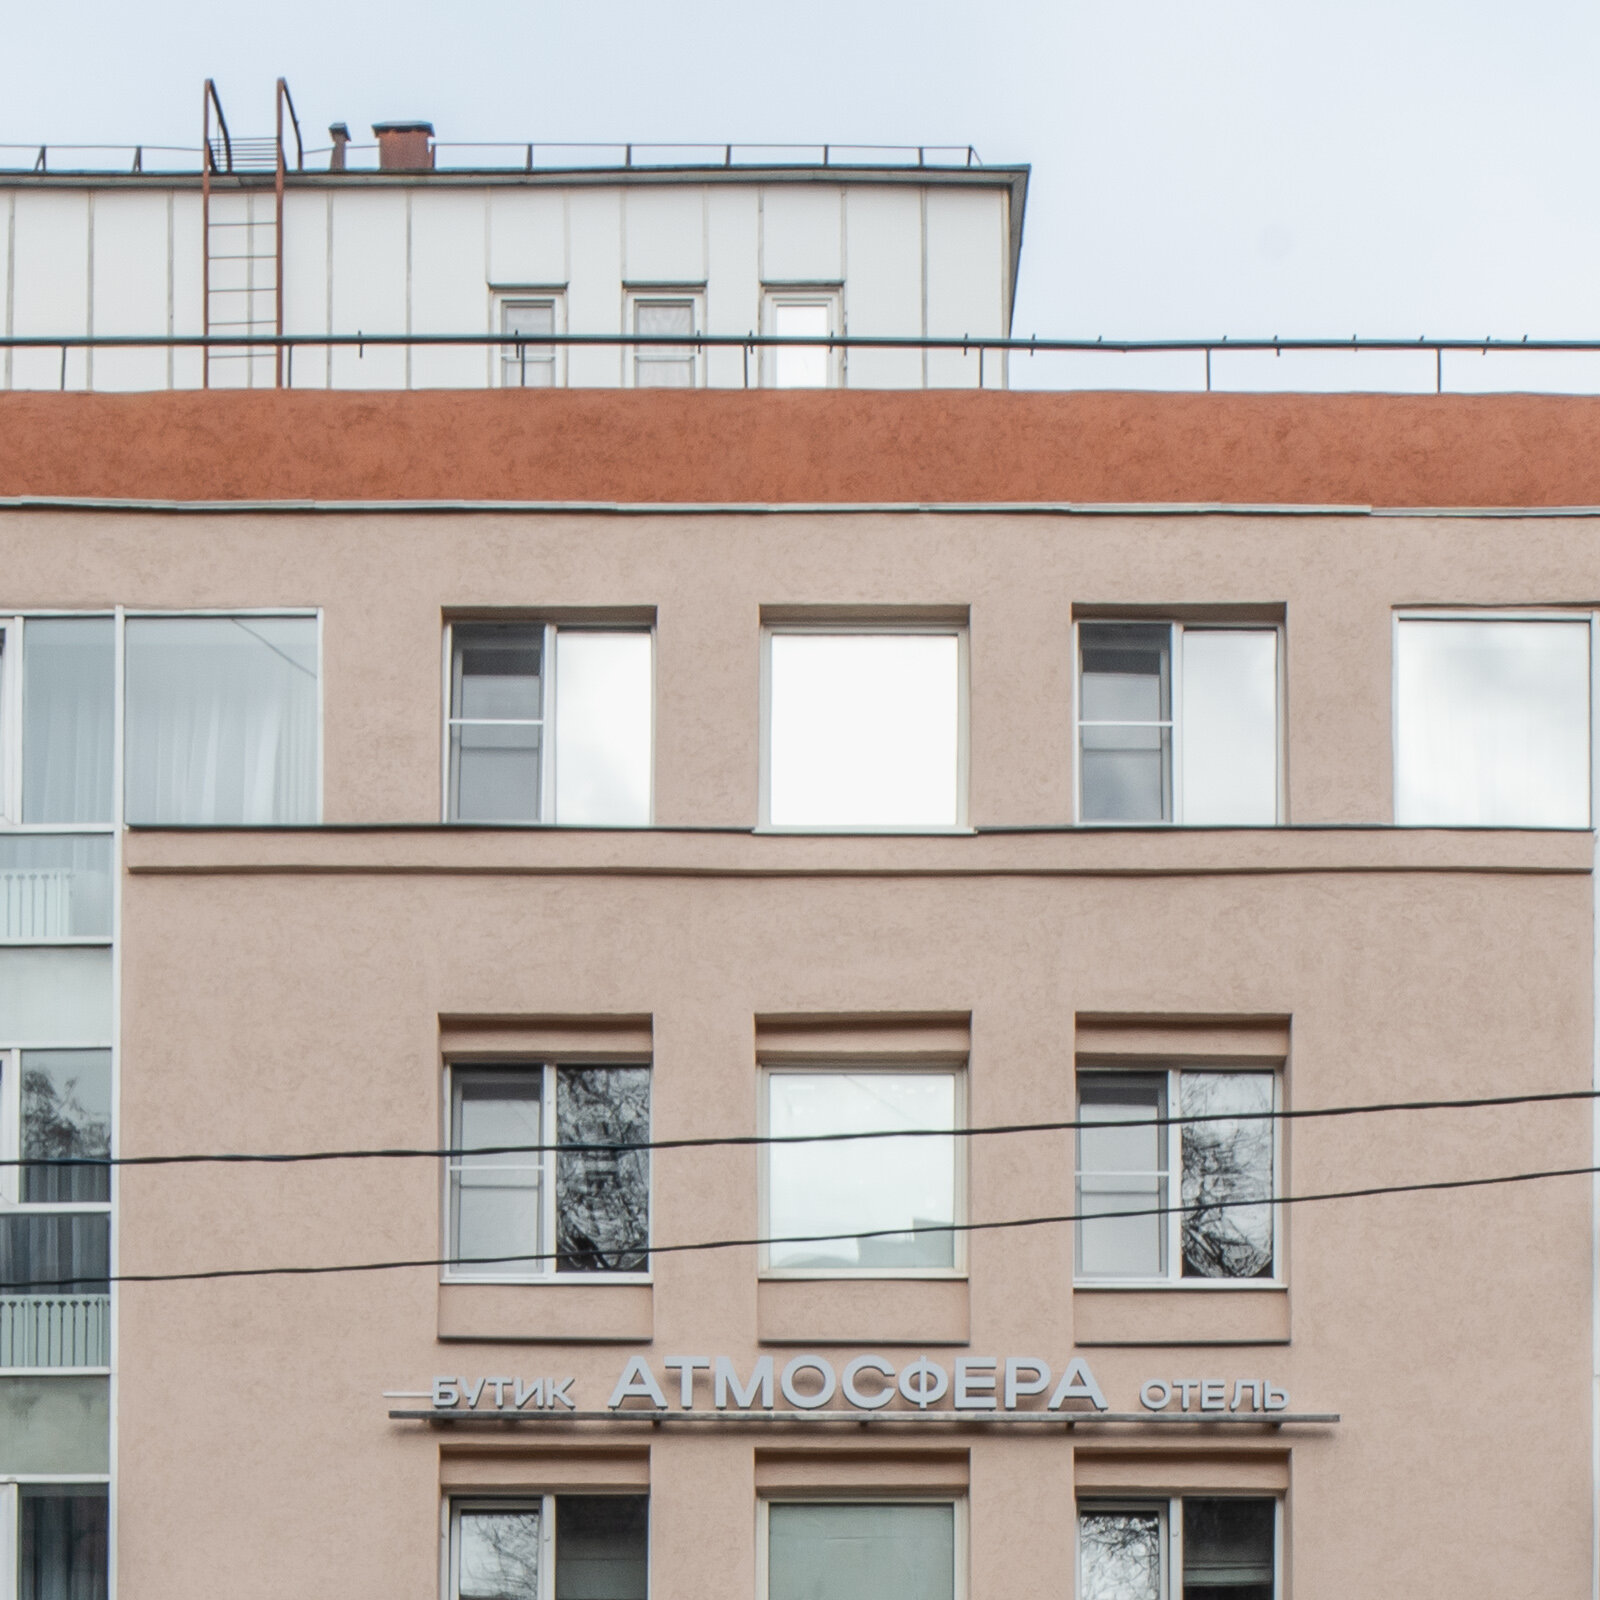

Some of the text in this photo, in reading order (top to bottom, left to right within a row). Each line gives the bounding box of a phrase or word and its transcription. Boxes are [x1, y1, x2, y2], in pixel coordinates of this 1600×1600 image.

[431, 1354, 1291, 1412] БУТИК АТМОСФЕРА ОТЕЛЬ
